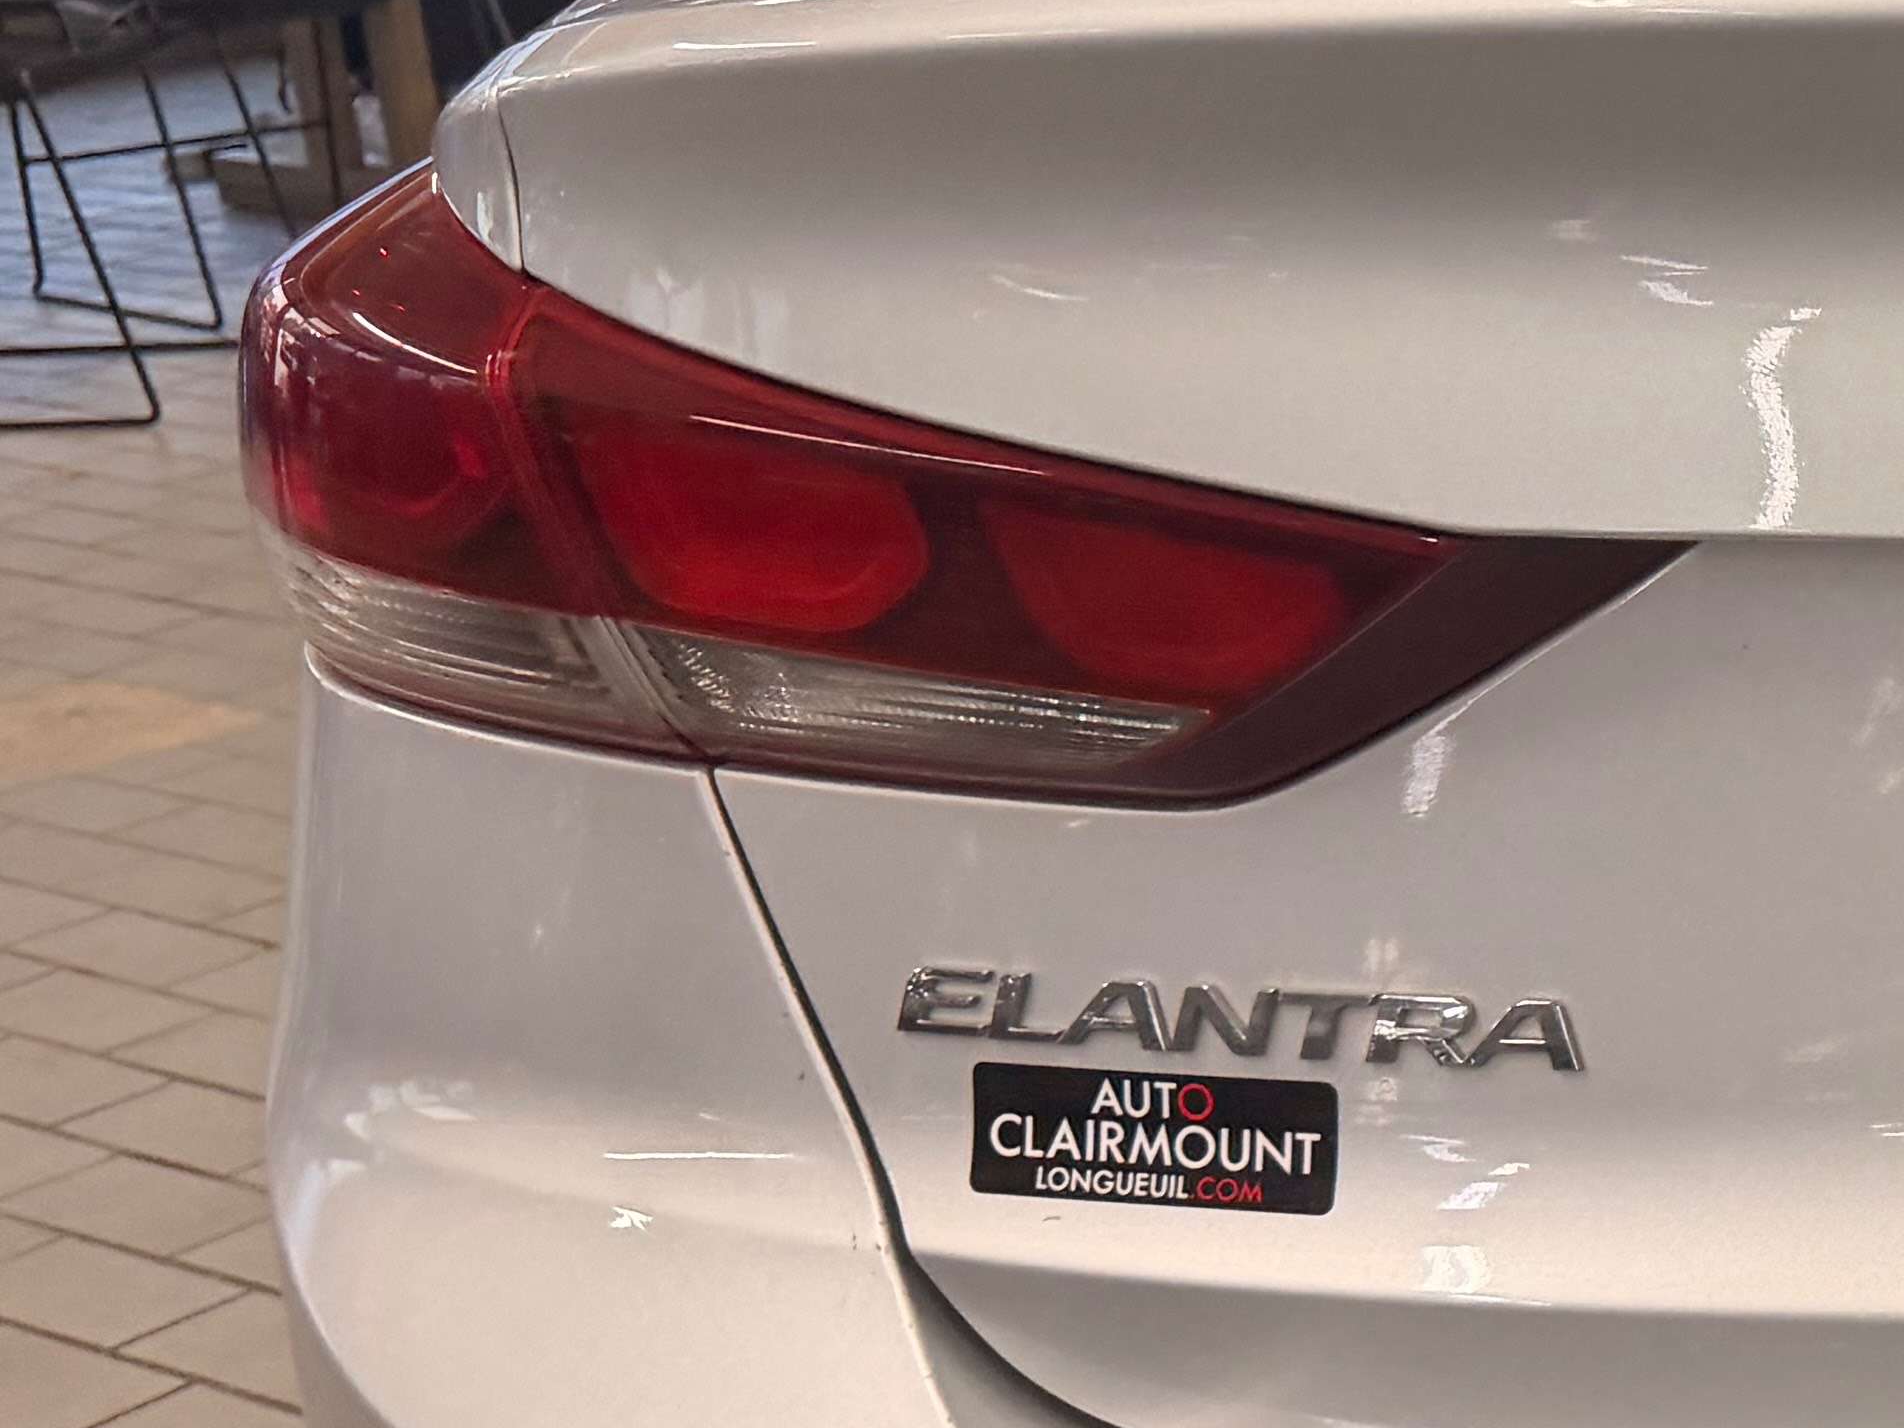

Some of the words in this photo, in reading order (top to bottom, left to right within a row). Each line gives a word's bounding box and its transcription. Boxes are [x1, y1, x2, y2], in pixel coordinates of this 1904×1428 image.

[898, 965, 1586, 1072] ELANTRA
[1091, 1078, 1214, 1122] AUTO
[989, 1113, 1322, 1176] CLAIRMOUNT
[1035, 1165, 1263, 1204] LONGUEUIL.COM
